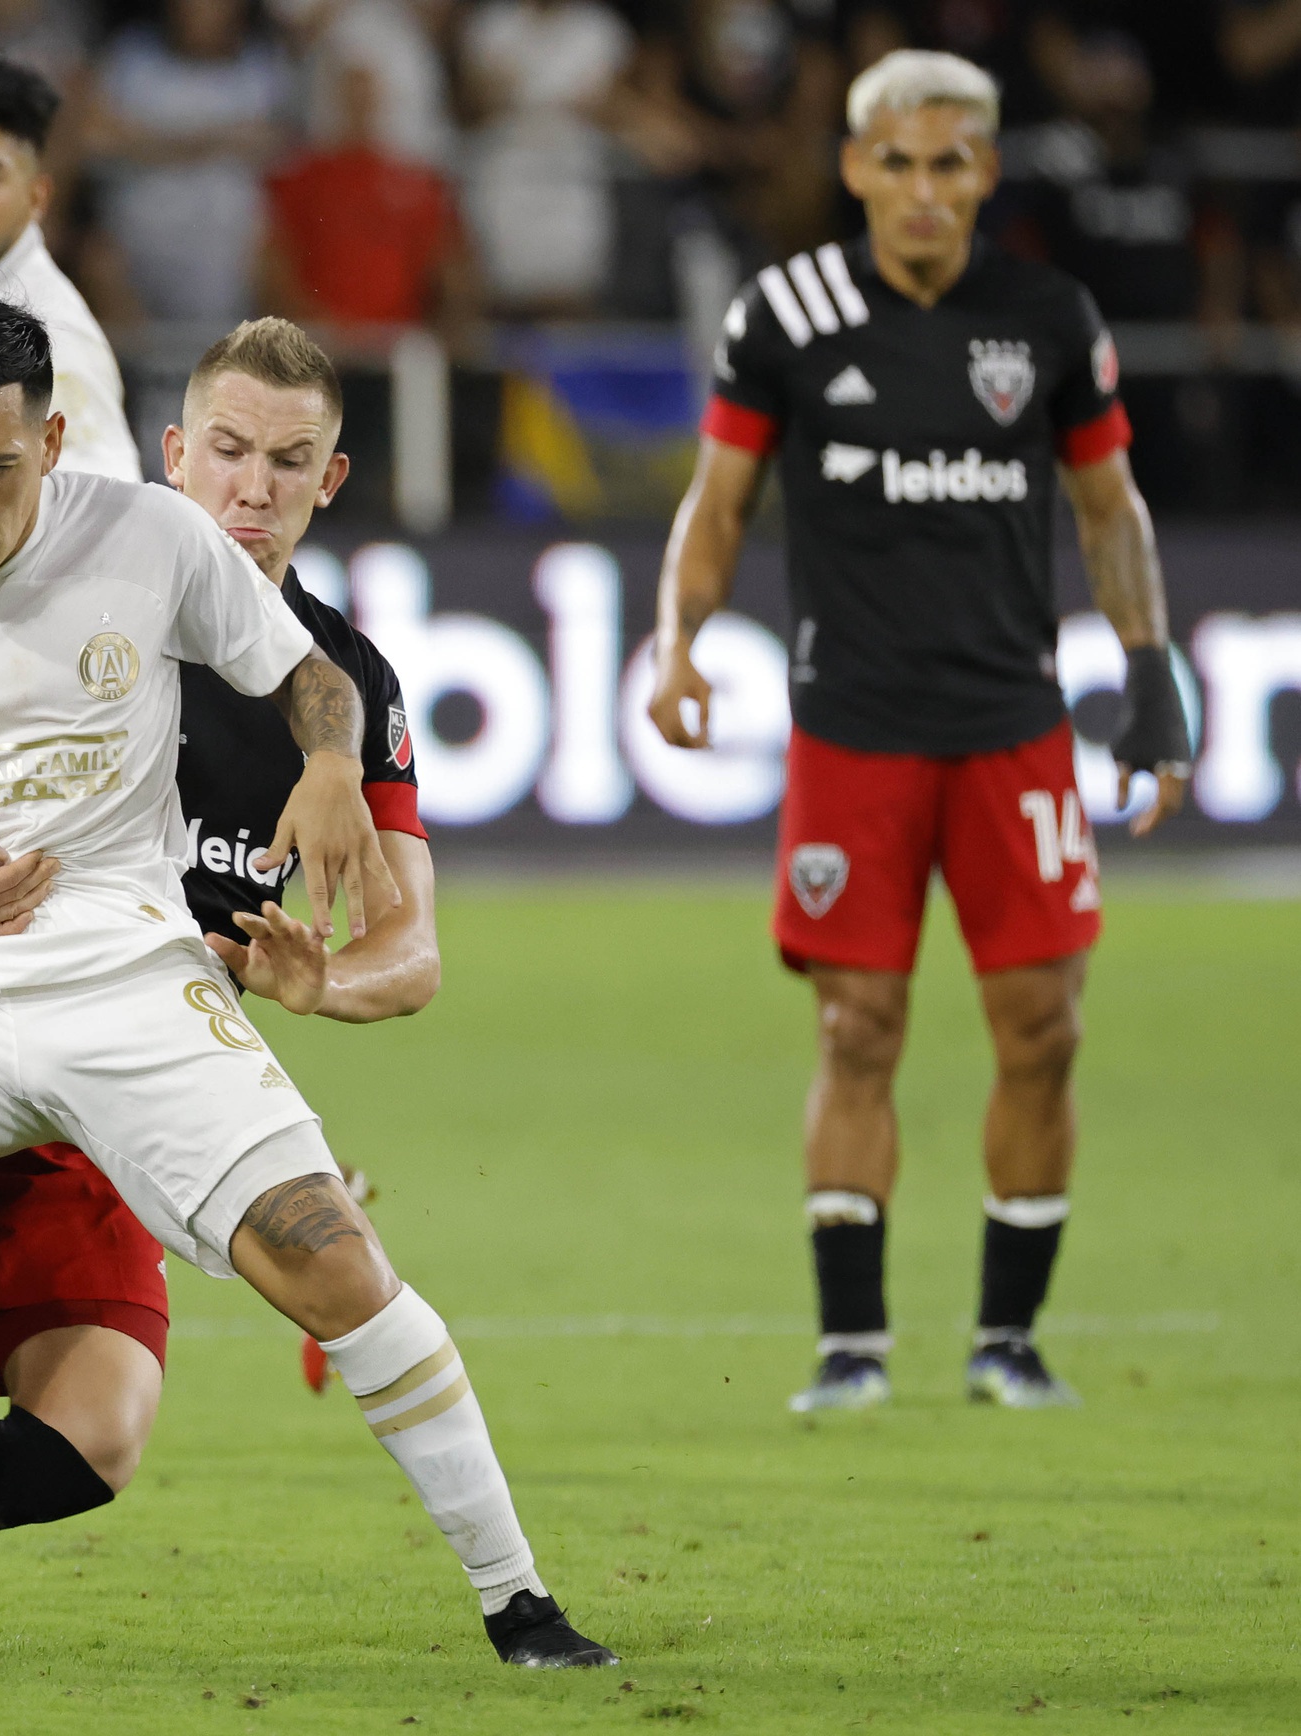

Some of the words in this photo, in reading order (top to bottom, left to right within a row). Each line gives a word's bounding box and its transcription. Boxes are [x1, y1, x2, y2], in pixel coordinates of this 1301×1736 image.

[883, 448, 1028, 503] leidos
[391, 712, 404, 728] MLS
[35, 746, 126, 775] FAMILY
[1018, 788, 1099, 884] 14
[183, 977, 266, 1052] 8
